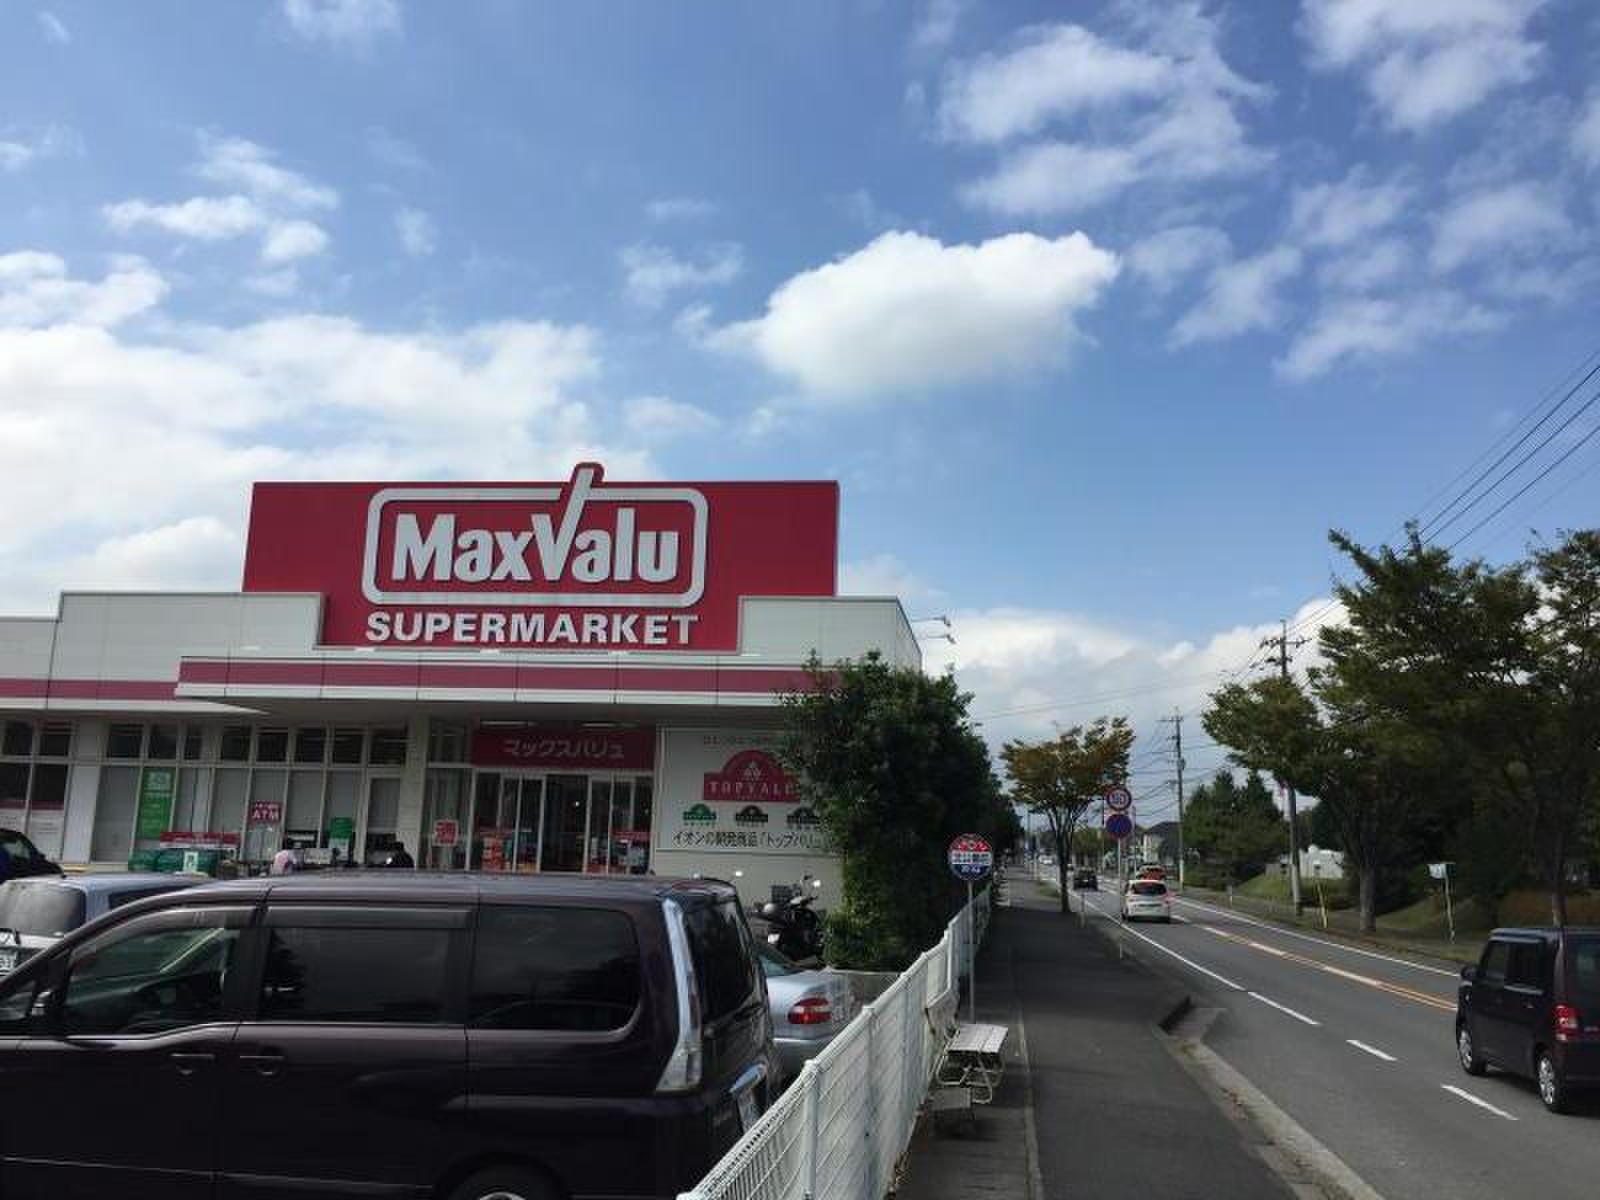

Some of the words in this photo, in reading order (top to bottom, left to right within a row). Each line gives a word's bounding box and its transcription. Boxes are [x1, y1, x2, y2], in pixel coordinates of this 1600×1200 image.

[390, 468, 680, 584] MaxValu
[365, 611, 699, 645] SUPERMARKET
[501, 736, 625, 760] マックスバリュ
[251, 807, 279, 821] ATM
